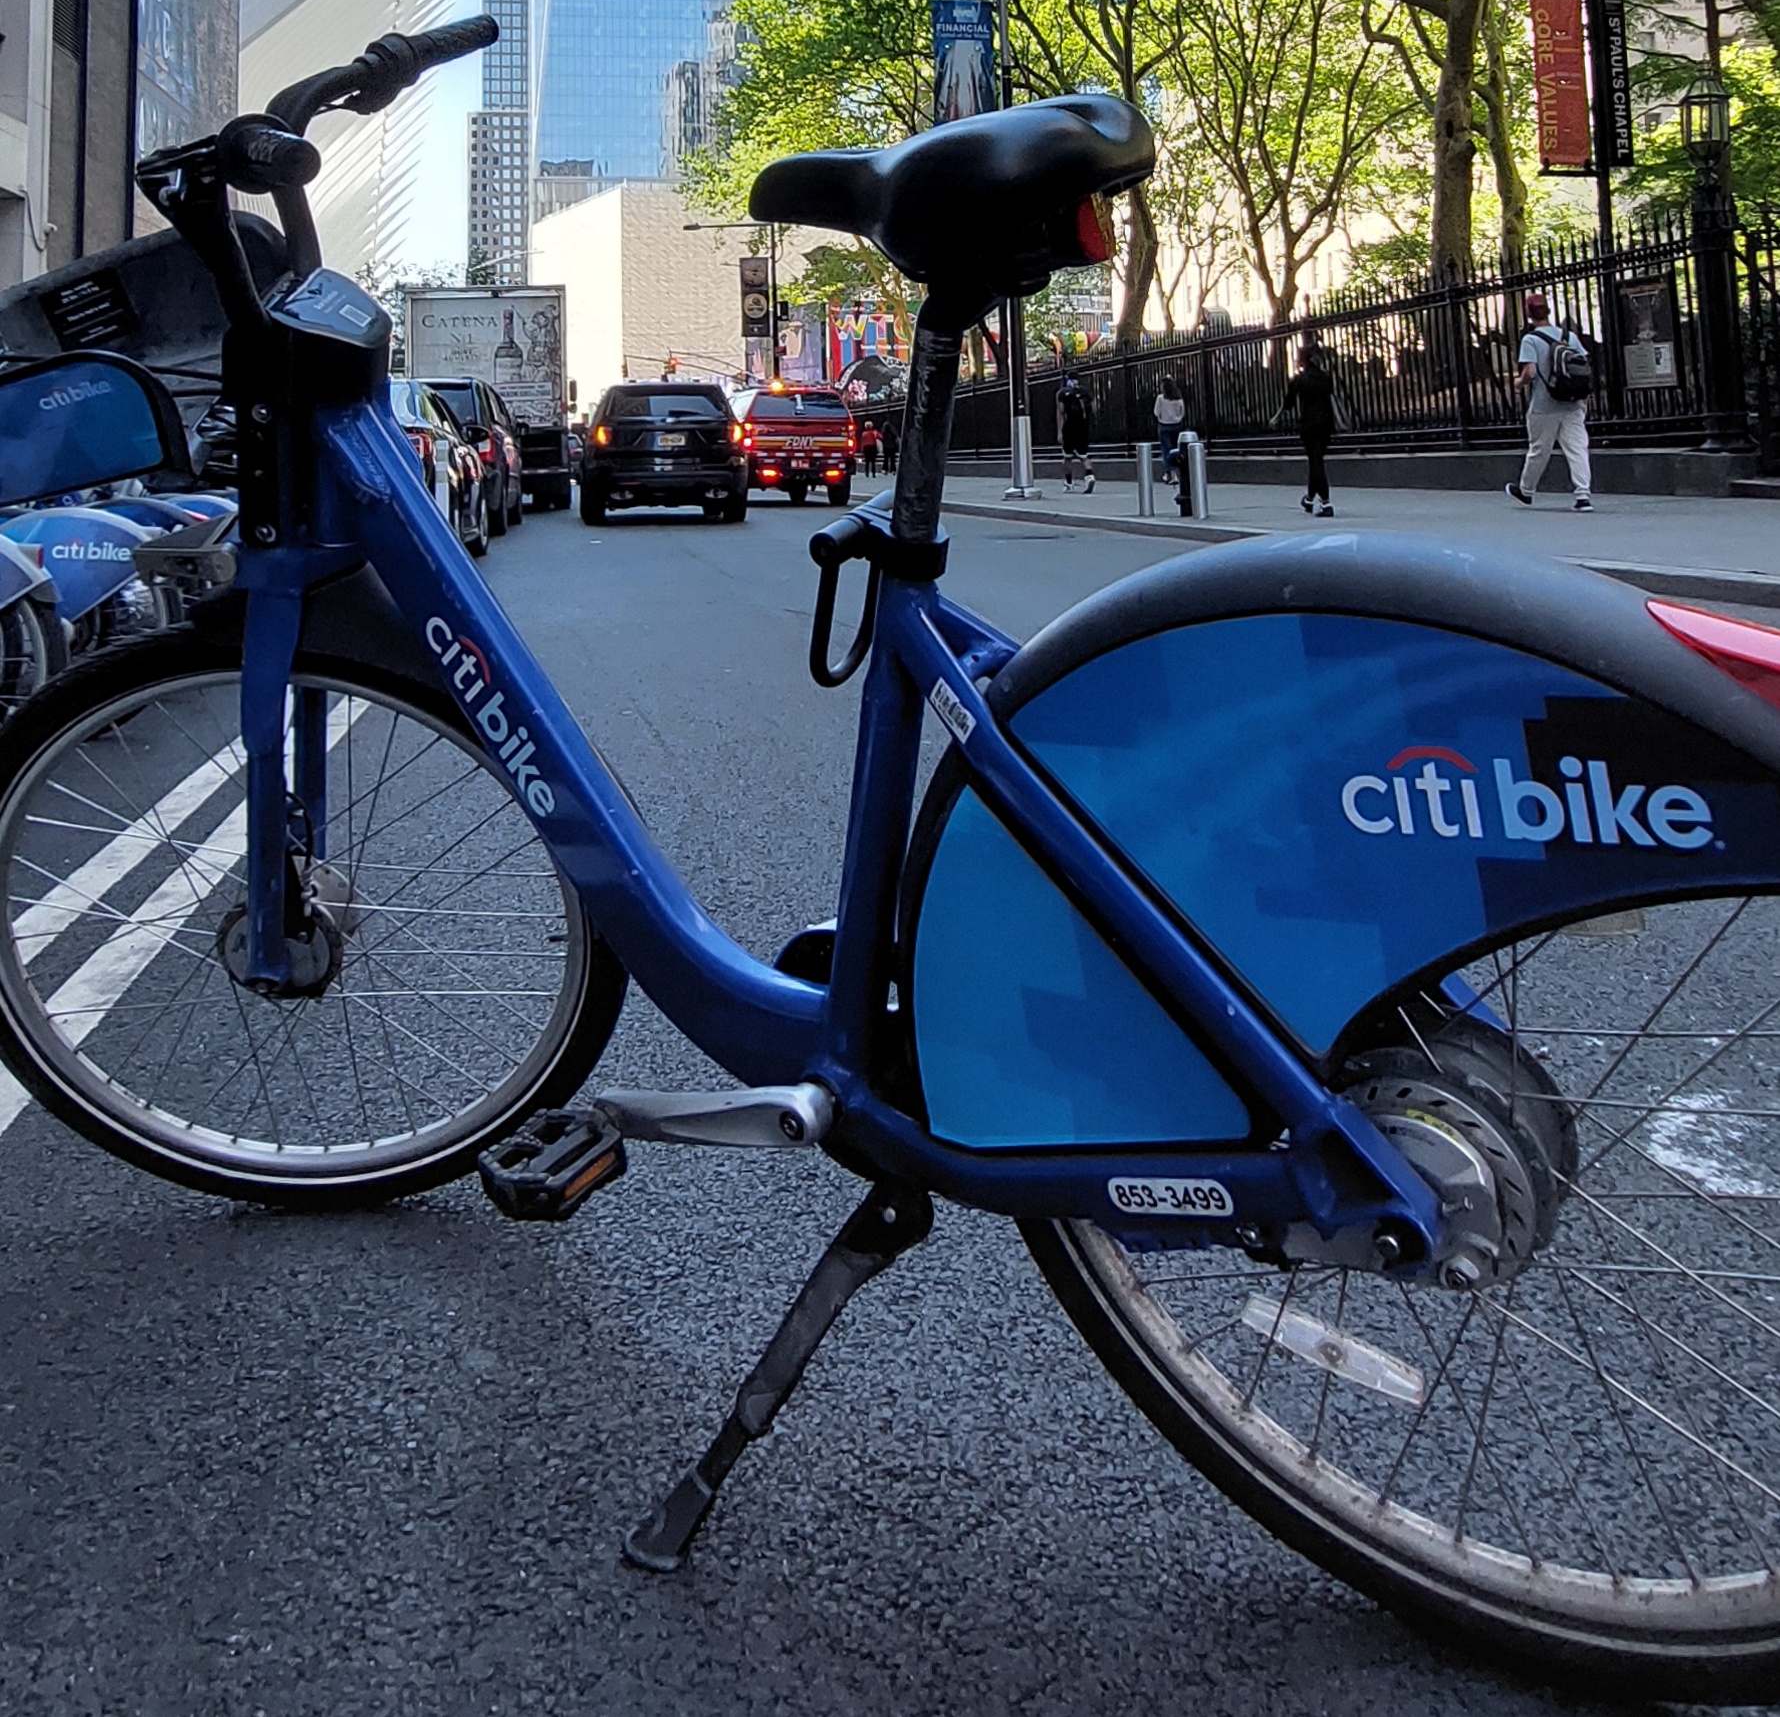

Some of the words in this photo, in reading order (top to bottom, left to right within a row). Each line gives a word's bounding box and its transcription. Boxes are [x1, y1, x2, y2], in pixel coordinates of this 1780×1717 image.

[935, 23, 990, 33] FINANCIAL
[1534, 8, 1555, 65] CORE
[1609, 36, 1625, 89] PAUL'S
[1539, 72, 1558, 150] VALUES
[1613, 91, 1630, 158] CHAPEL
[421, 314, 498, 328] CATENA
[39, 387, 71, 410] citi
[68, 380, 113, 402] bike
[785, 436, 815, 447] FDNY
[52, 540, 85, 560] citi
[87, 541, 132, 561] bike
[425, 617, 487, 703] citi
[476, 691, 556, 817] bike
[1341, 748, 1484, 838] citi
[1493, 756, 1714, 849] bike
[1115, 1184, 1227, 1211] 853-3499
